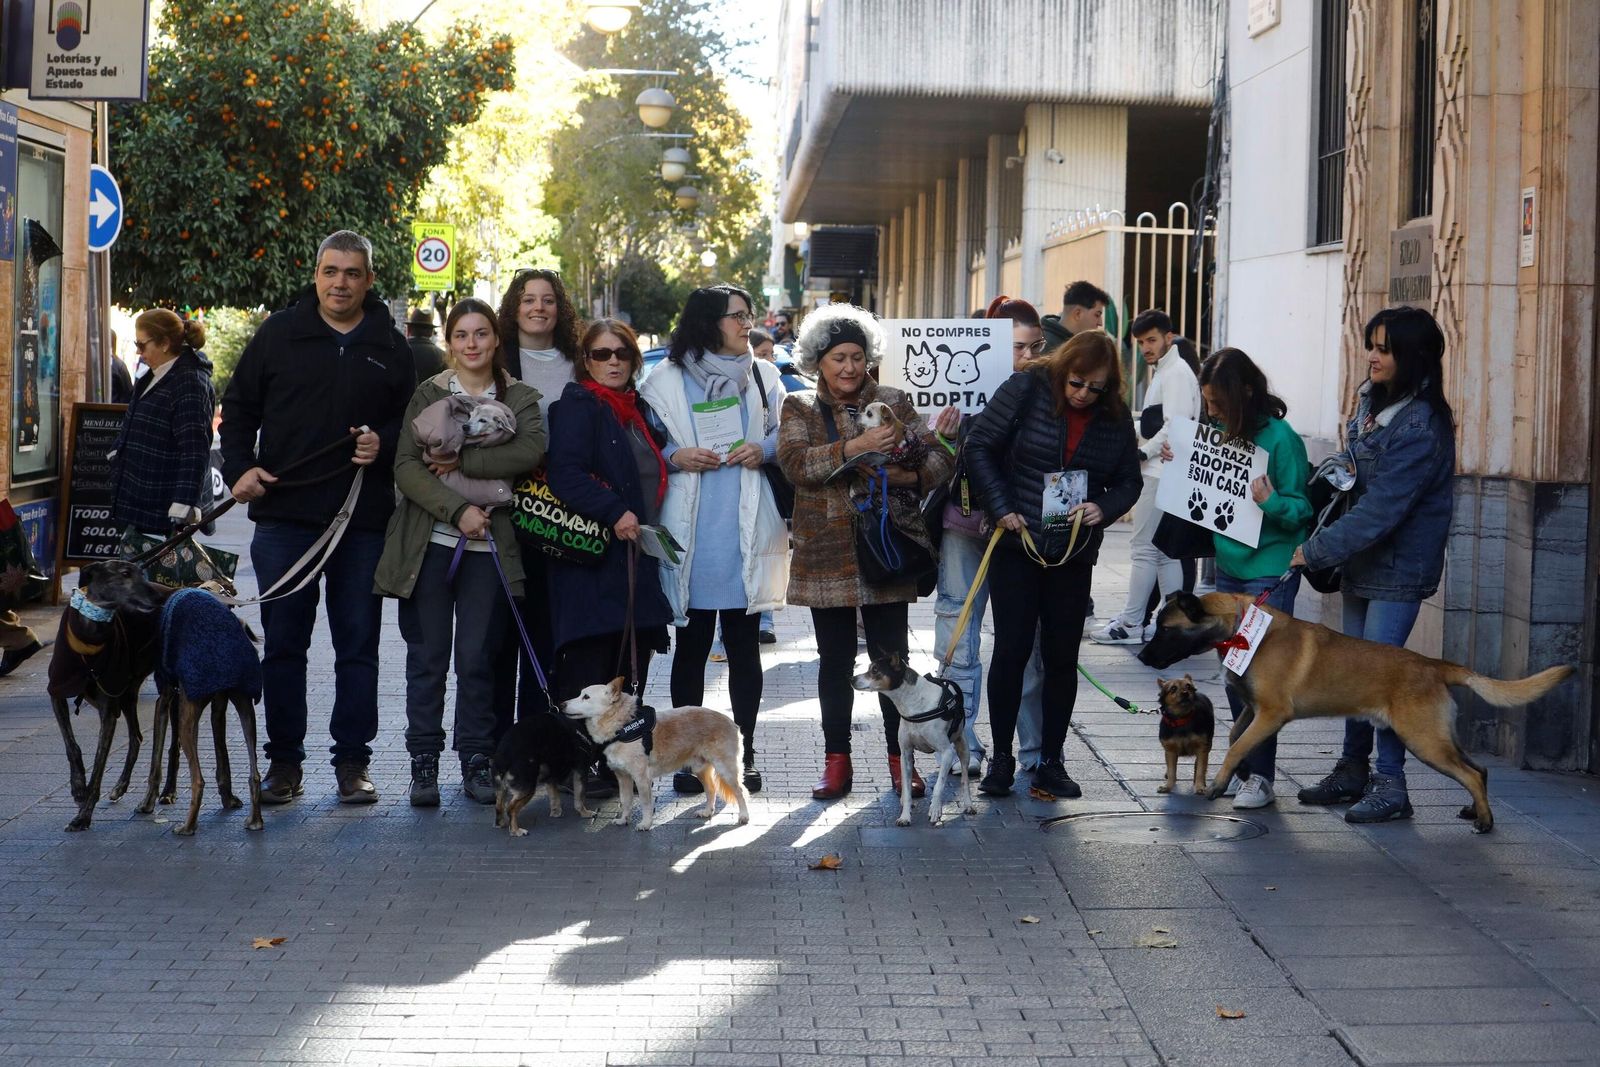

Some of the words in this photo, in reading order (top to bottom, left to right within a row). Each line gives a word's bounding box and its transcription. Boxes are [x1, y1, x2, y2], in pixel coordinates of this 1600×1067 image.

[47, 53, 91, 63] Loterías
[95, 56, 101, 66] y
[47, 67, 97, 78] Apuestas
[101, 67, 117, 76] del
[46, 79, 83, 89] Estado
[422, 248, 445, 262] 20
[902, 327, 921, 337] NO
[926, 327, 991, 337] COMPRES
[83, 419, 104, 427] MENÚ
[1195, 424, 1224, 447] NO
[1193, 441, 1209, 452] UNO
[1209, 448, 1220, 456] DE
[1221, 447, 1252, 468] RAZA
[1190, 451, 1249, 483] ADOPTA
[1193, 467, 1214, 486] SIN
[1217, 476, 1246, 499] CASA
[74, 509, 110, 520] TODO
[521, 496, 600, 537] COLOMBIA
[562, 531, 605, 554] COLO
[95, 544, 112, 555] 6€
